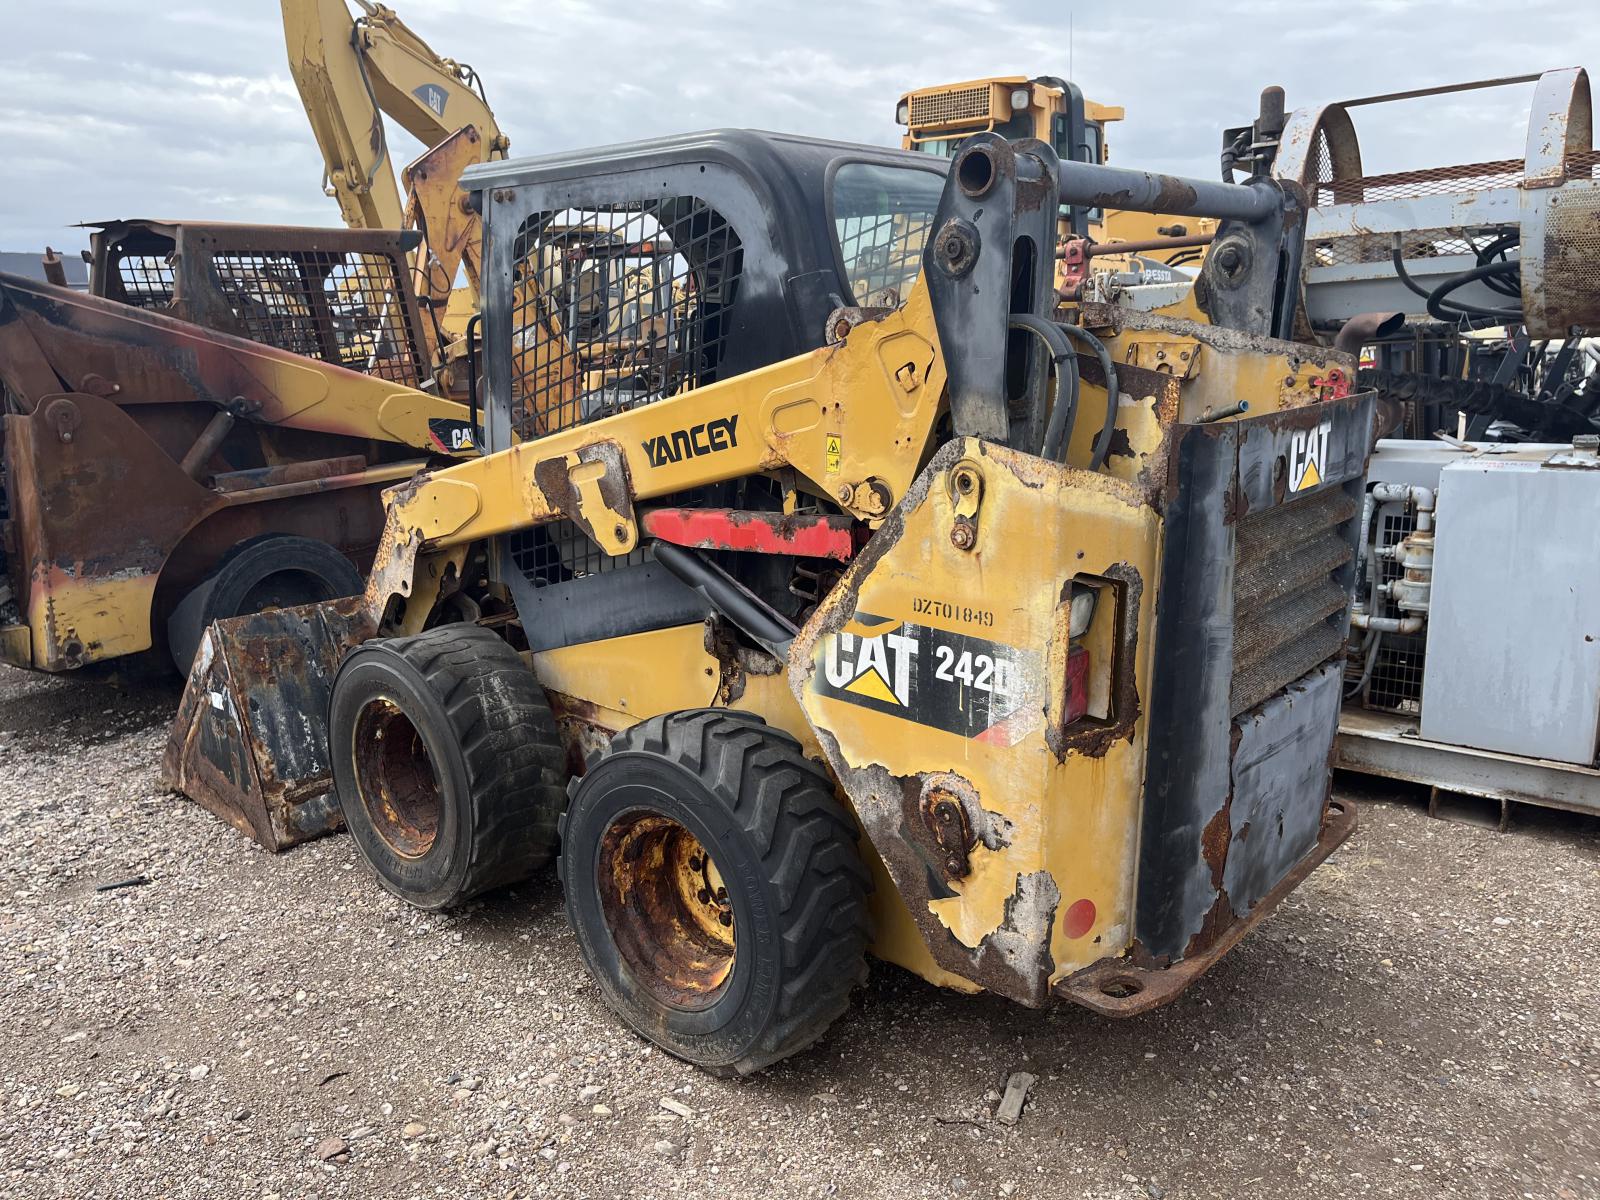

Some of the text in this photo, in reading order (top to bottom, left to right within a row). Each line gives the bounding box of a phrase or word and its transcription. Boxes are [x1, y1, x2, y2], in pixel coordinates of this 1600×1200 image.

[428, 88, 441, 115] CAT
[1359, 345, 1377, 362] AT
[641, 414, 739, 468] YANCEY
[1288, 419, 1332, 493] CAT
[913, 597, 994, 627] DZT01849
[824, 633, 1016, 708] CAT 242D
